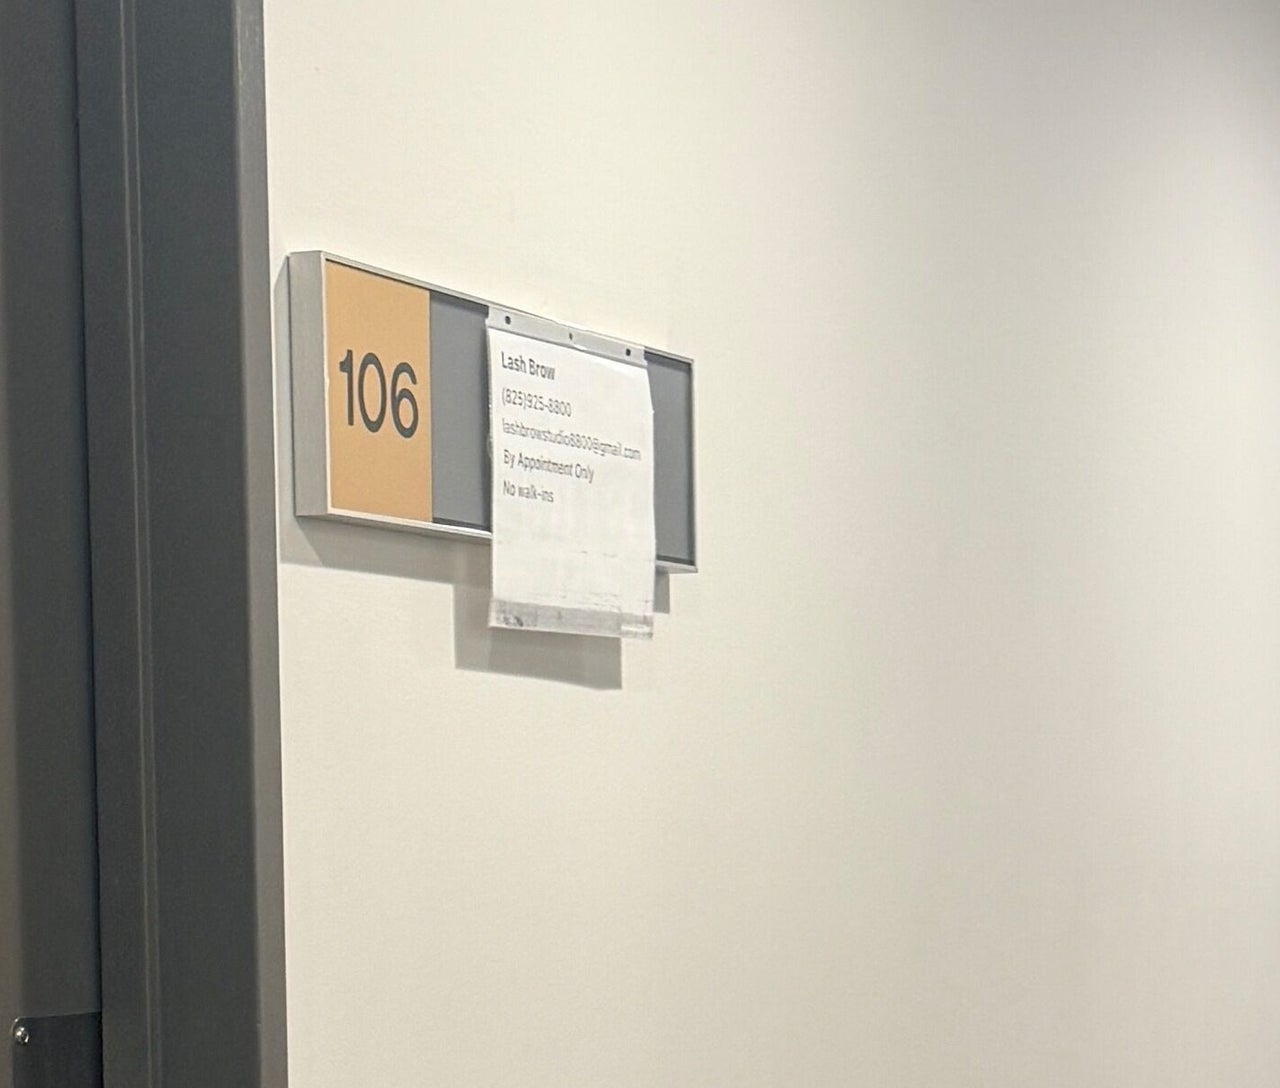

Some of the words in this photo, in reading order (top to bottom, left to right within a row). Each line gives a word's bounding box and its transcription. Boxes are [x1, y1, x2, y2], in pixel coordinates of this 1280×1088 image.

[501, 351, 528, 374] Lash
[529, 358, 556, 381] Brow
[339, 348, 419, 439] 106
[501, 386, 572, 417] (825)925-8800
[502, 418, 642, 461] lashbrowstudio8800@gmail.com
[503, 448, 515, 469] By
[517, 452, 574, 477] Appointment
[575, 463, 595, 484] Only
[503, 480, 516, 496] No
[517, 483, 555, 503] walk-ins
